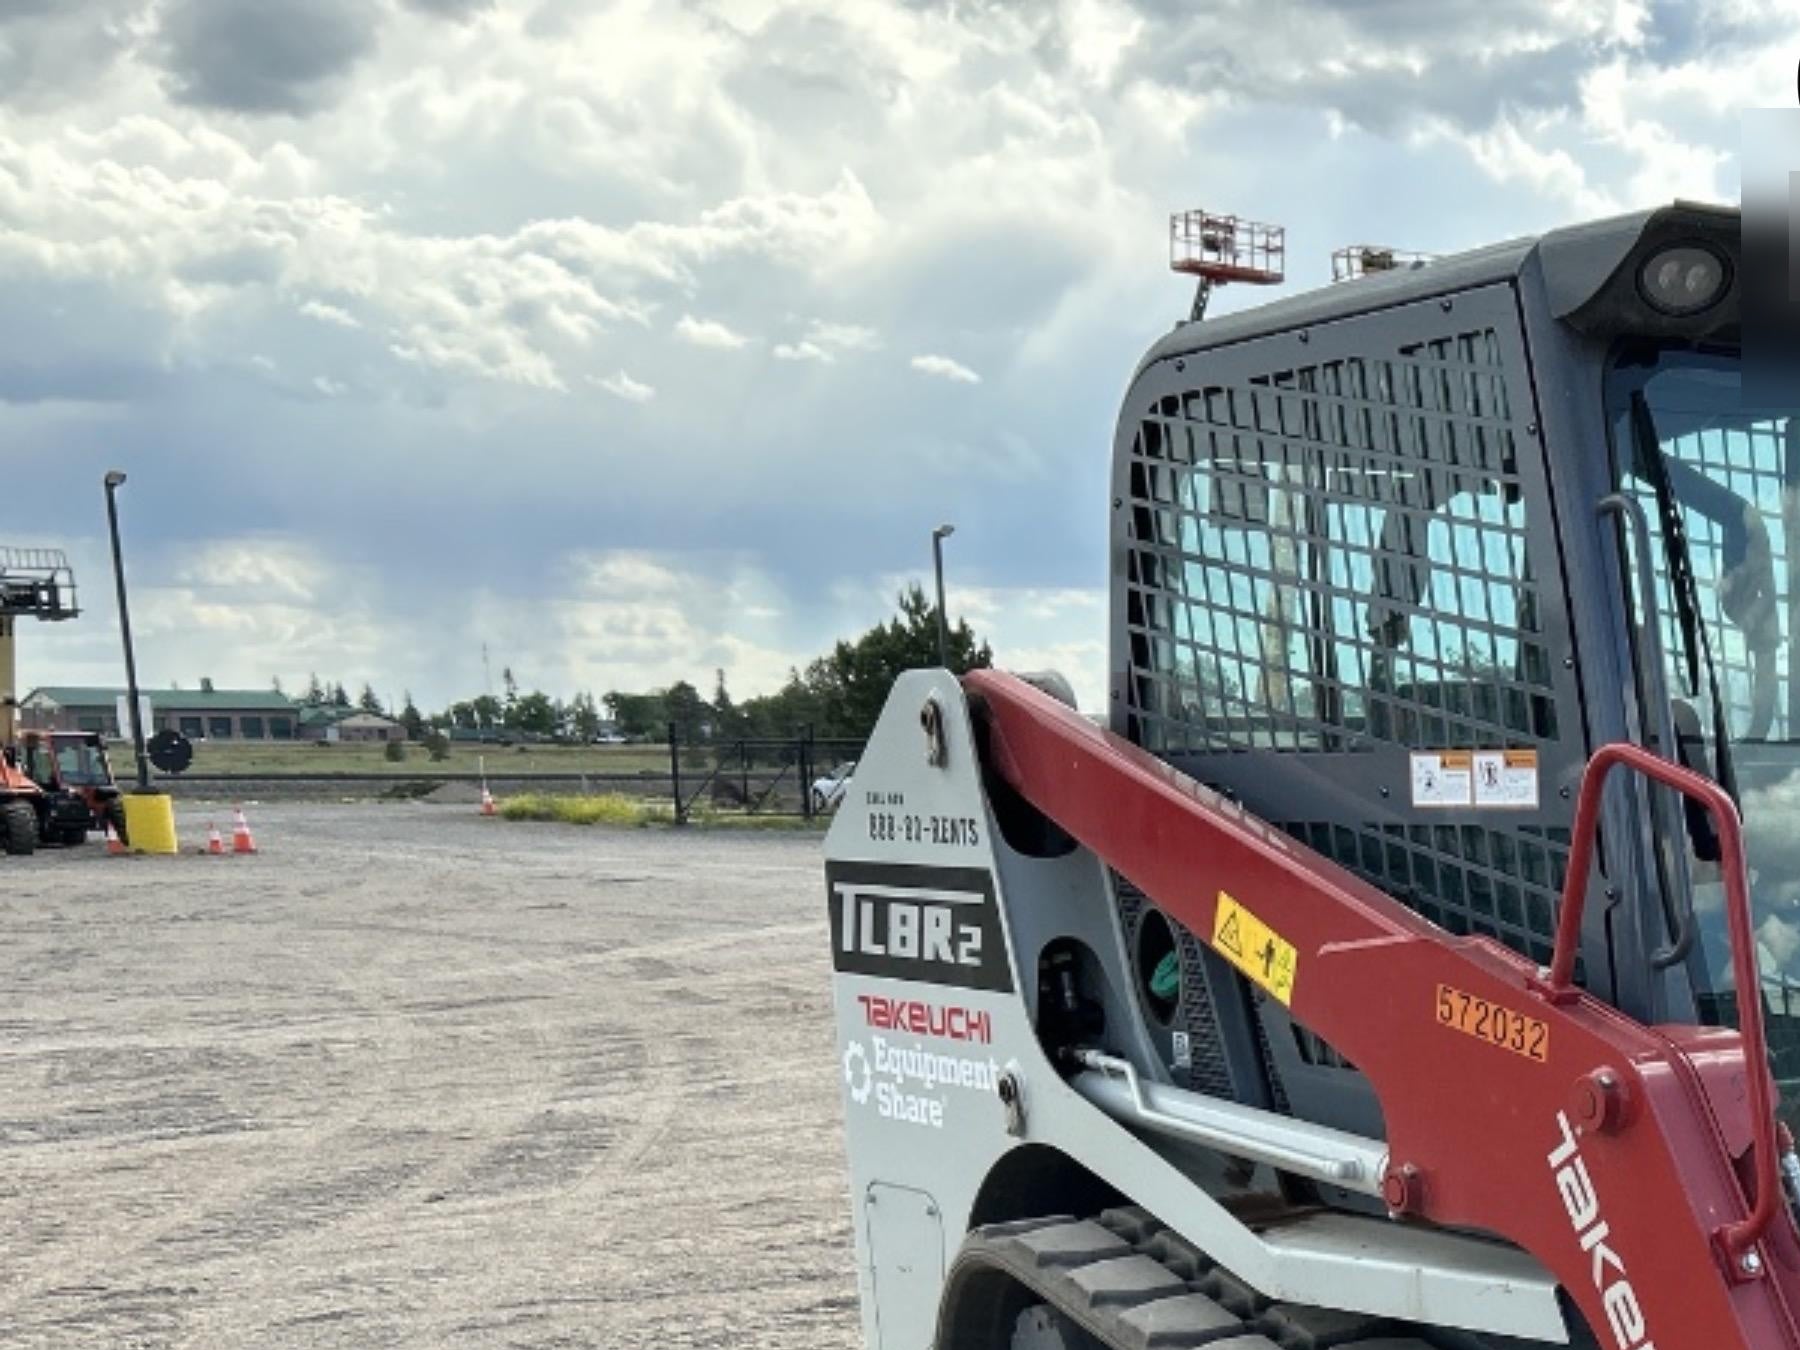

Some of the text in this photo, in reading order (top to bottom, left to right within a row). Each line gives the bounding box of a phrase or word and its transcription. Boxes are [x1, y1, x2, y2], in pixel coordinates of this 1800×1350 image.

[857, 995, 992, 1045] TAKEUCHI
[1439, 985, 1546, 1060] 572032
[871, 1036, 999, 1092] Equipment
[875, 1082, 944, 1128] Share
